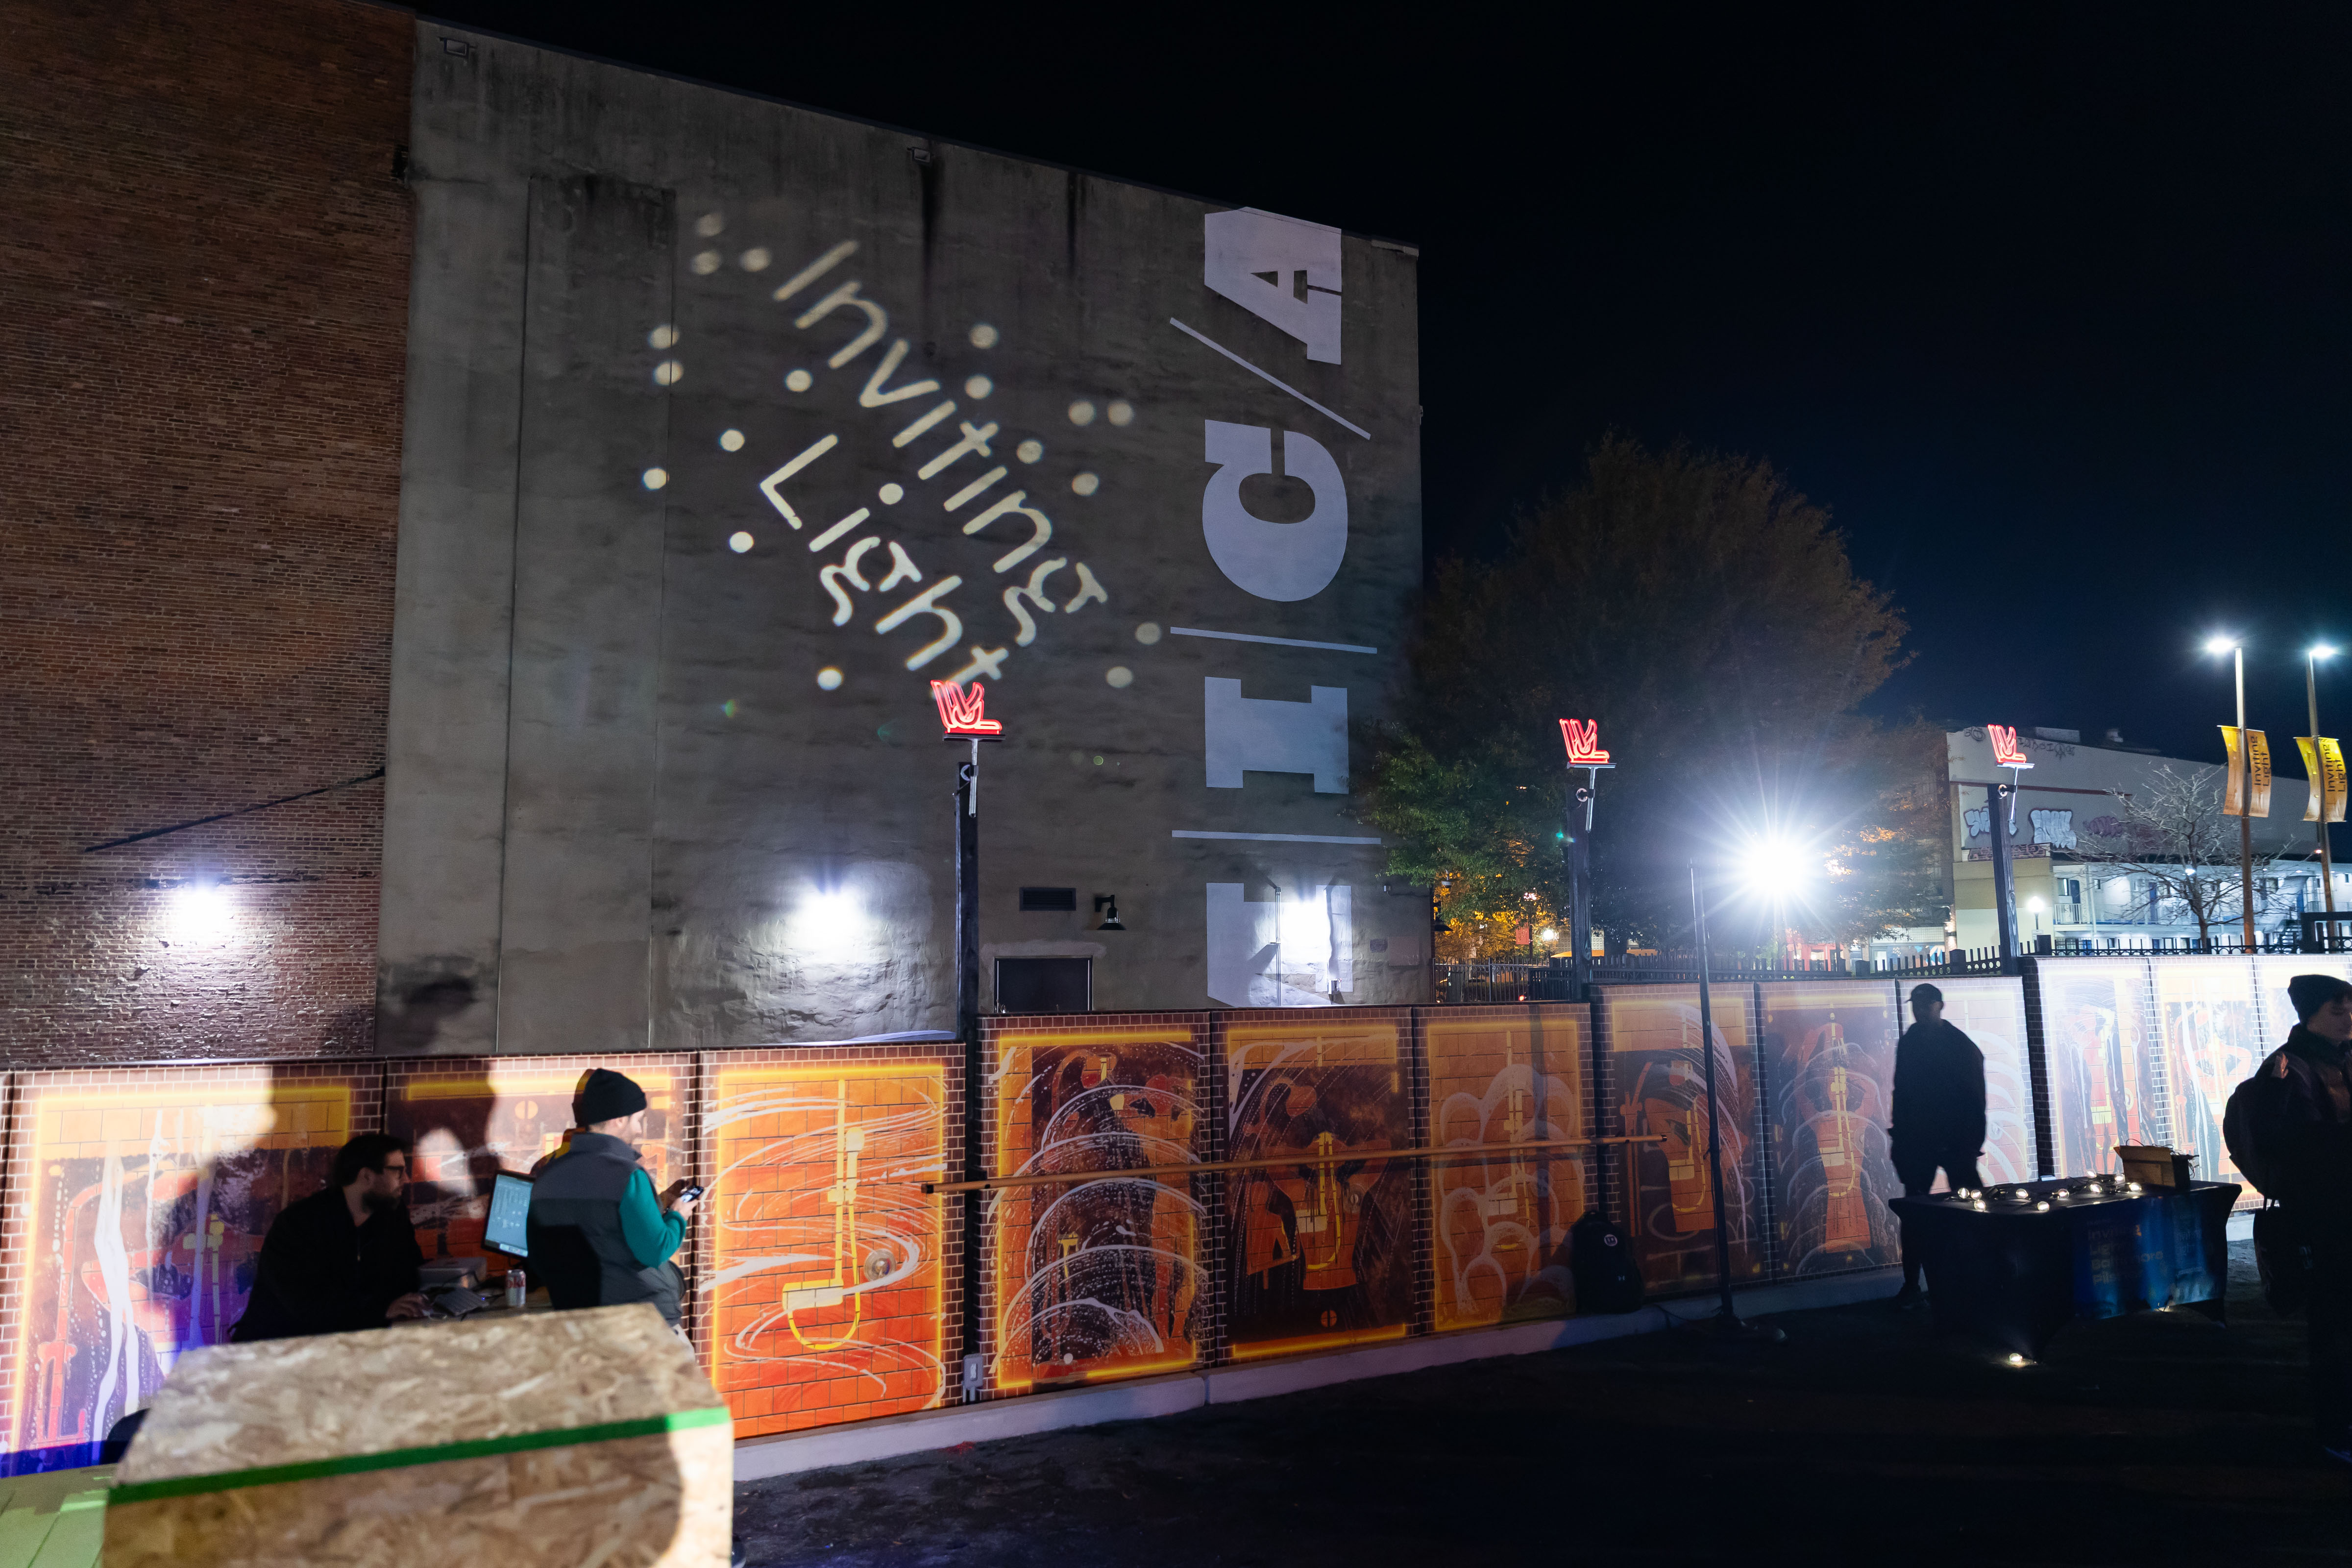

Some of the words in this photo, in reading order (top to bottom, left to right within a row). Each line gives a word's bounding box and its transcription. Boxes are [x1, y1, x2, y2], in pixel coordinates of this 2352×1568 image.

[774, 240, 1108, 646] Inviting
[760, 434, 1009, 699] Light
[2250, 736, 2262, 786] Inviting
[2261, 752, 2271, 786] Light
[2323, 744, 2335, 792] Inviting
[2335, 759, 2346, 792] Light
